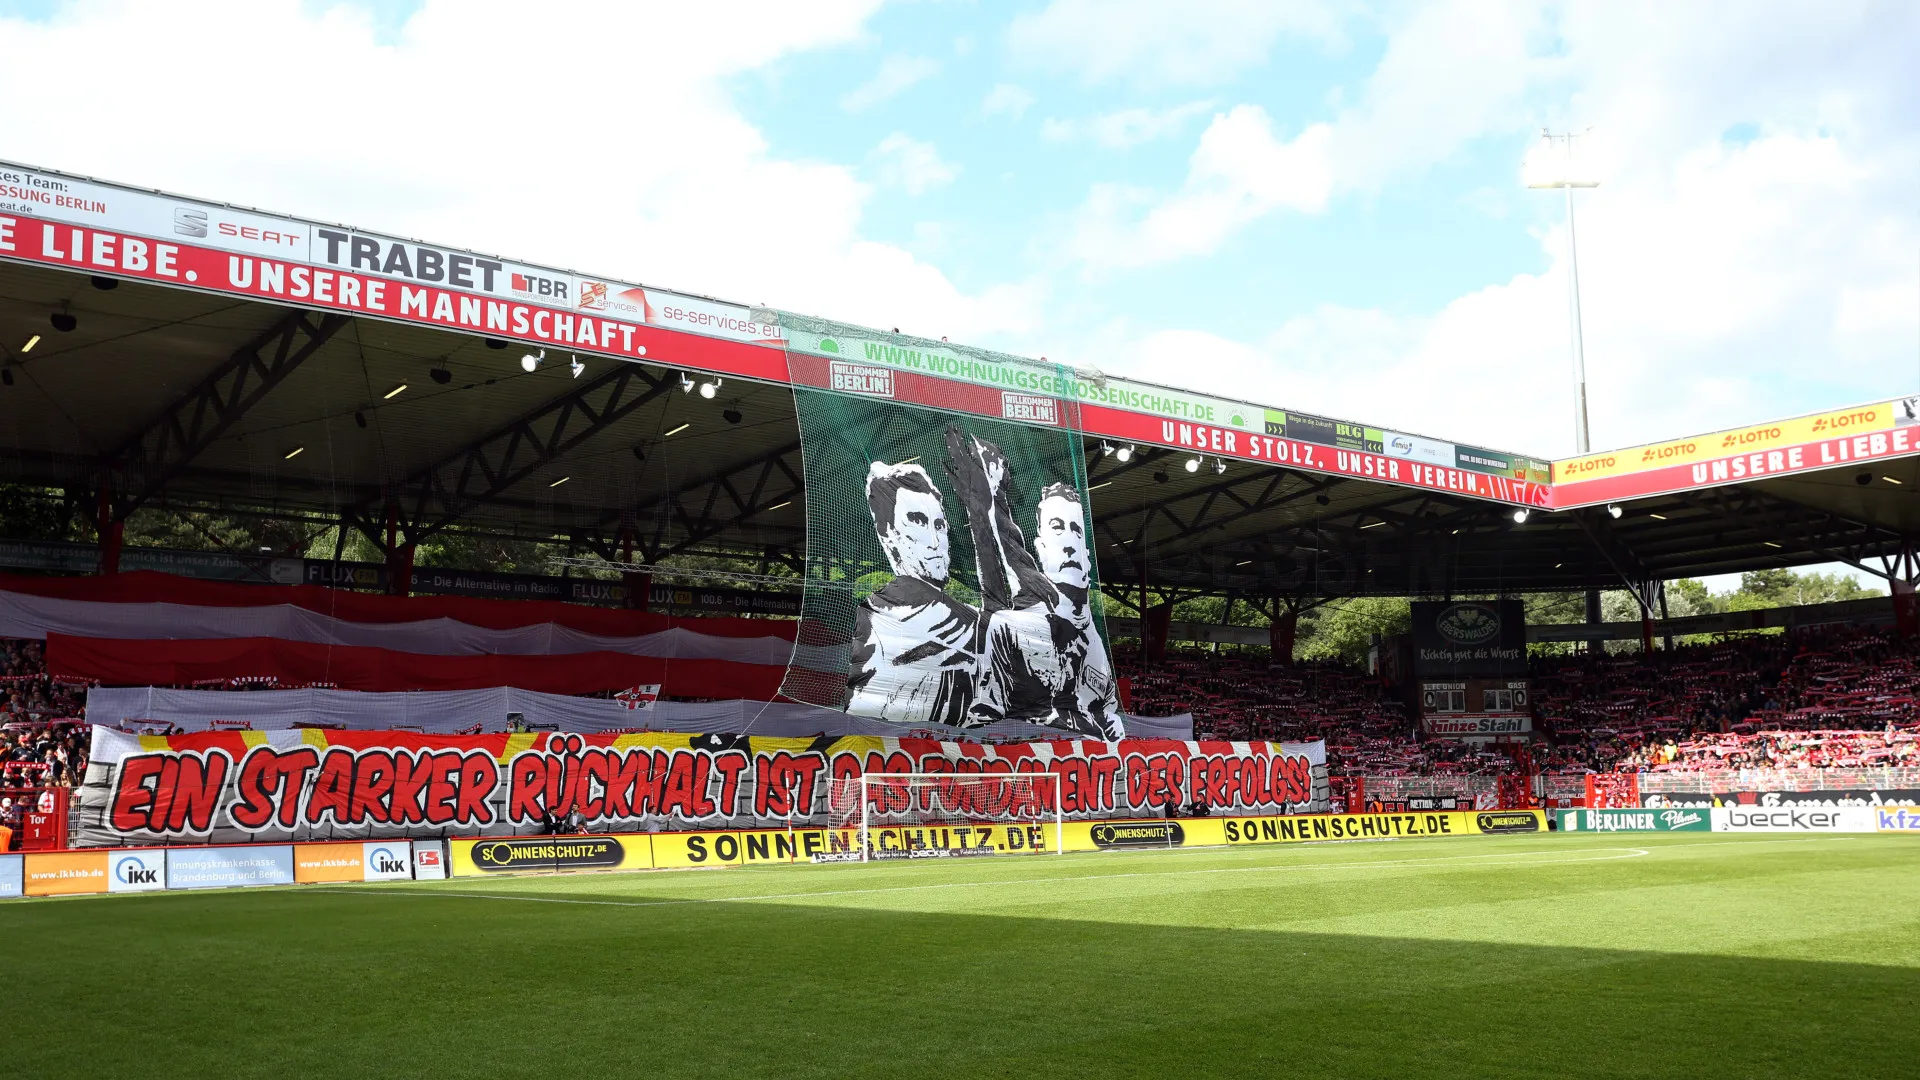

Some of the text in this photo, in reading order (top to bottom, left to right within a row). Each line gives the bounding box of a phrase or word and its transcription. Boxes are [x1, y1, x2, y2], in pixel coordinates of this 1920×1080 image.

[25, 174, 68, 193] Team:
[0, 201, 33, 213] eat.de
[55, 194, 106, 214] BERLIN
[218, 222, 300, 247] SEAT
[318, 229, 502, 292] TRABET
[42, 224, 198, 282] LIEBE.
[228, 256, 386, 311] UNSERE
[400, 288, 647, 355] MANNSCHAFT.
[523, 274, 568, 299] TBR
[597, 300, 638, 313] services
[663, 305, 781, 338] se-services.eu
[833, 364, 890, 378] WILLKOMMEN
[833, 373, 890, 394] BERLIN!
[1005, 394, 1053, 407] WILLKOMMEN
[1005, 403, 1054, 422] BERLIN!
[1831, 411, 1876, 428] LOTTO
[1336, 423, 1361, 438] BUG
[1739, 428, 1781, 445] LOTTO
[1162, 420, 1485, 494] UNSER STOLZ. UNSER VEREIN.
[1658, 443, 1696, 460] LOTTO
[1692, 429, 1920, 484] UNSERE LIEBE.
[1579, 457, 1616, 472] LOTTO
[308, 565, 356, 583] FLUX
[434, 575, 452, 588] Die
[455, 576, 512, 592] Alternative
[514, 580, 528, 593] im
[530, 581, 563, 595] Radio.
[572, 583, 610, 600] FLUX
[701, 594, 797, 610] 100.6 Die Alternative
[1439, 619, 1498, 640] EBERSWALDER
[1420, 646, 1520, 663] Richtig gut die Wurst
[1442, 682, 1466, 690] UNION
[1507, 681, 1526, 689] GAST
[1425, 691, 1435, 707] 0
[1515, 690, 1526, 705] 0
[108, 750, 230, 834] EIN
[230, 746, 499, 829] STARKER
[508, 734, 747, 825] RÜCKHALT
[753, 750, 824, 818] IST
[830, 751, 913, 816] DAS
[1126, 753, 1184, 810] DES
[1189, 753, 1313, 812] ERFOLGS!
[30, 814, 47, 825] Tor
[1586, 810, 1701, 831] BERLINER Pilsner
[1729, 809, 1841, 829] becker
[1879, 811, 1920, 829] kfz
[34, 828, 40, 838] 1
[1226, 815, 1451, 842] SONNENSCHUTZ.DE
[482, 841, 607, 865] SONNENSCHUTZ.DE
[686, 826, 1045, 863] SONNENSCHUTZ.DE
[172, 858, 276, 871] Innungskrankenkasse
[300, 858, 361, 868] www.ikkbb.de
[31, 868, 104, 880] www.ikkbb.de
[173, 869, 285, 883] Brandenburg und Berlin
